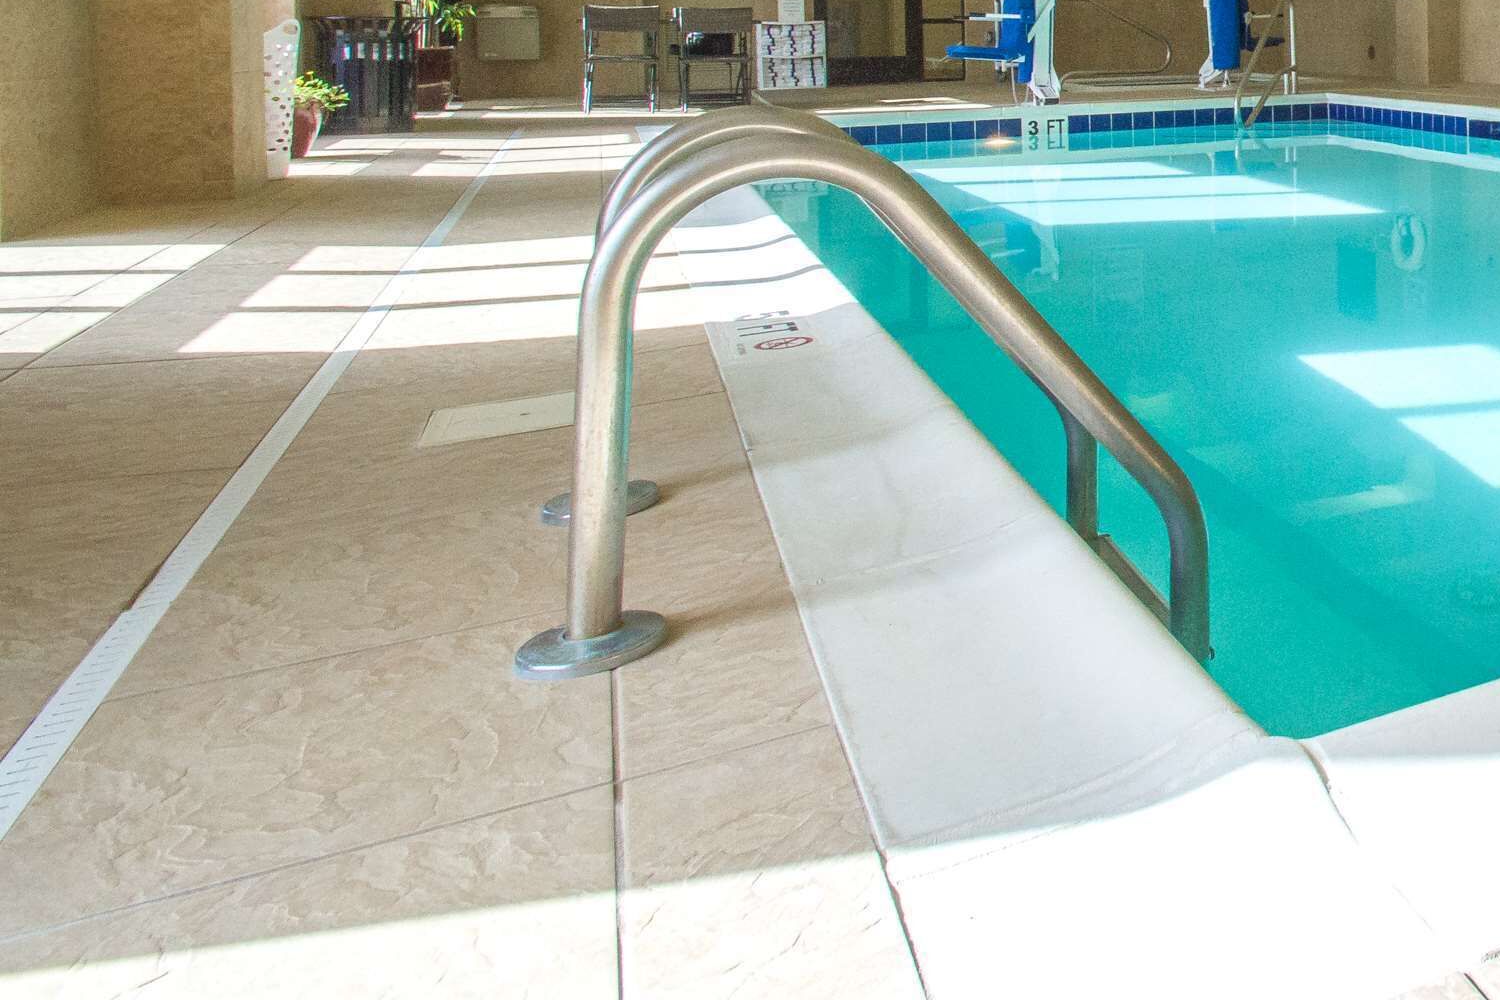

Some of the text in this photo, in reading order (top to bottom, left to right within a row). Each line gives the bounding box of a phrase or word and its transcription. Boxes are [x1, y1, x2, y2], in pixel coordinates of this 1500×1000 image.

[1028, 119, 1065, 136] 3 FT
[737, 321, 799, 337] FT
